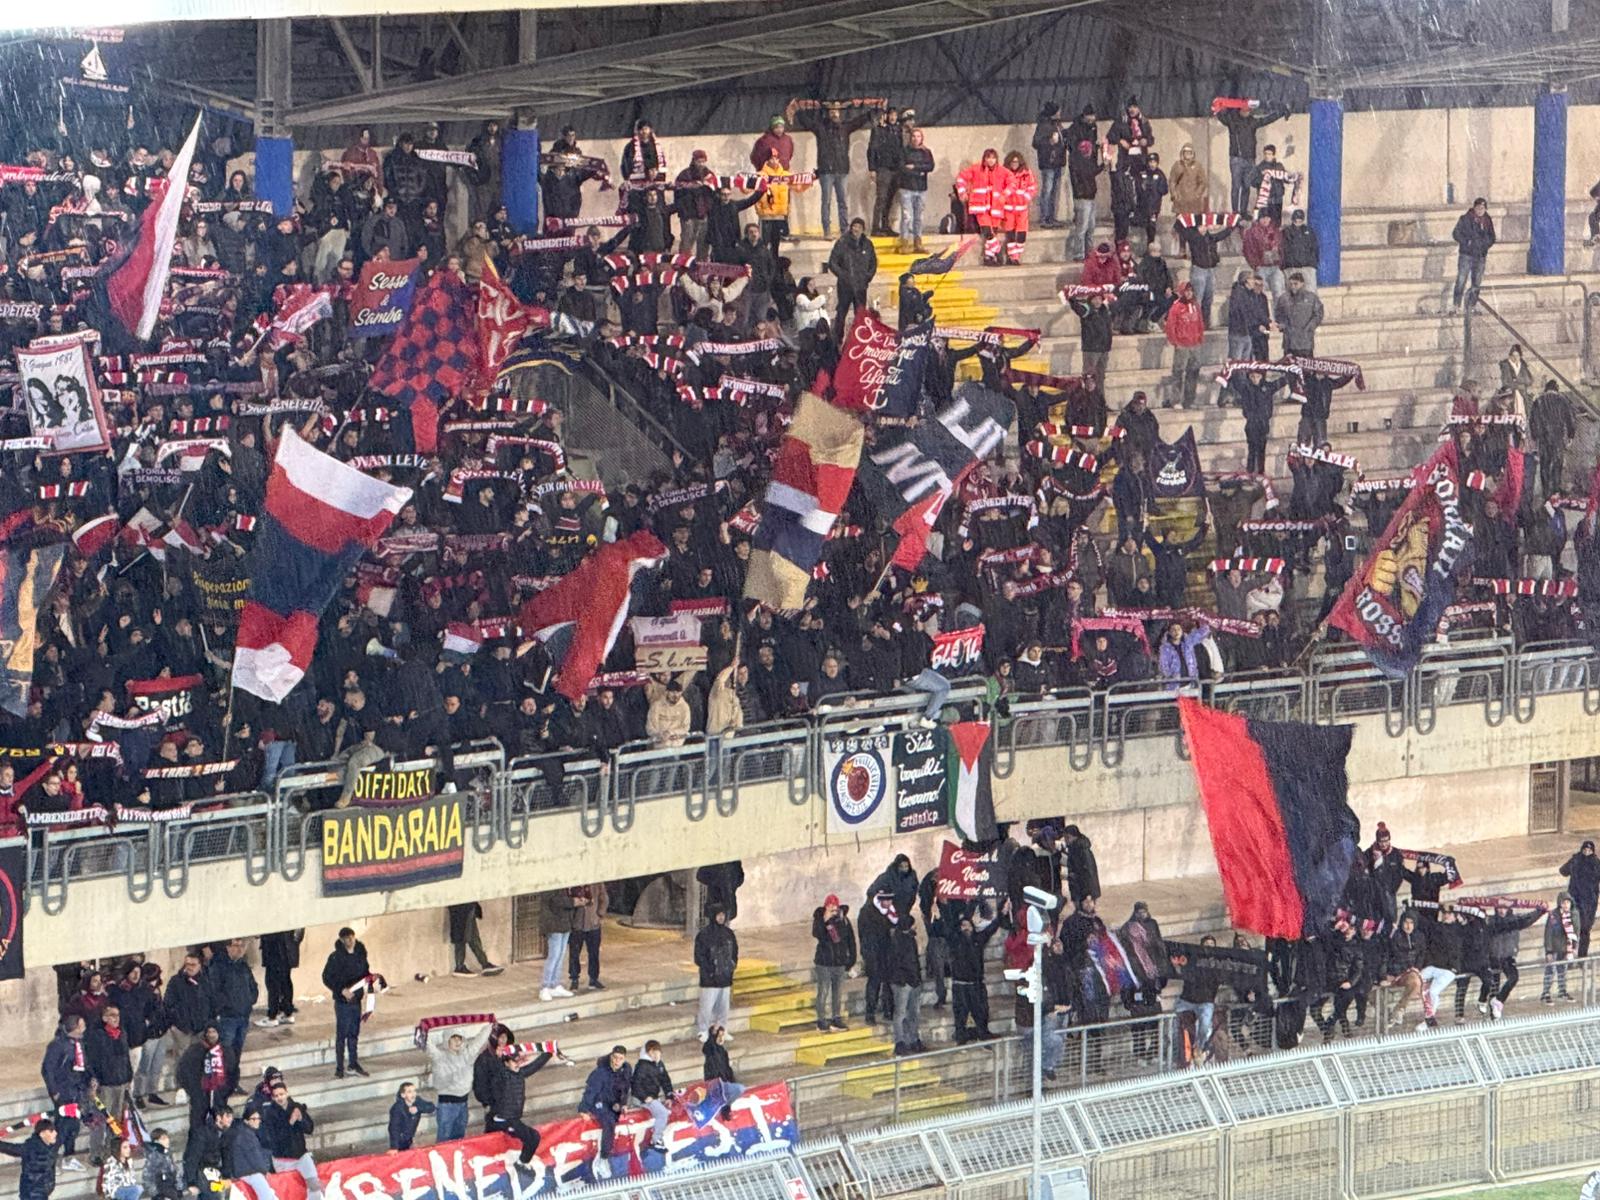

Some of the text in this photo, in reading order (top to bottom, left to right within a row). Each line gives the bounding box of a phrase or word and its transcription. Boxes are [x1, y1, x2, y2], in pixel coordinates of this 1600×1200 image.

[368, 271, 409, 291] Sesso
[354, 306, 403, 326] Samba
[354, 769, 430, 800] DIFFIDATI
[323, 801, 463, 867] BANDARAIA
[961, 866, 990, 884] Vento
[938, 878, 962, 899] Ma
